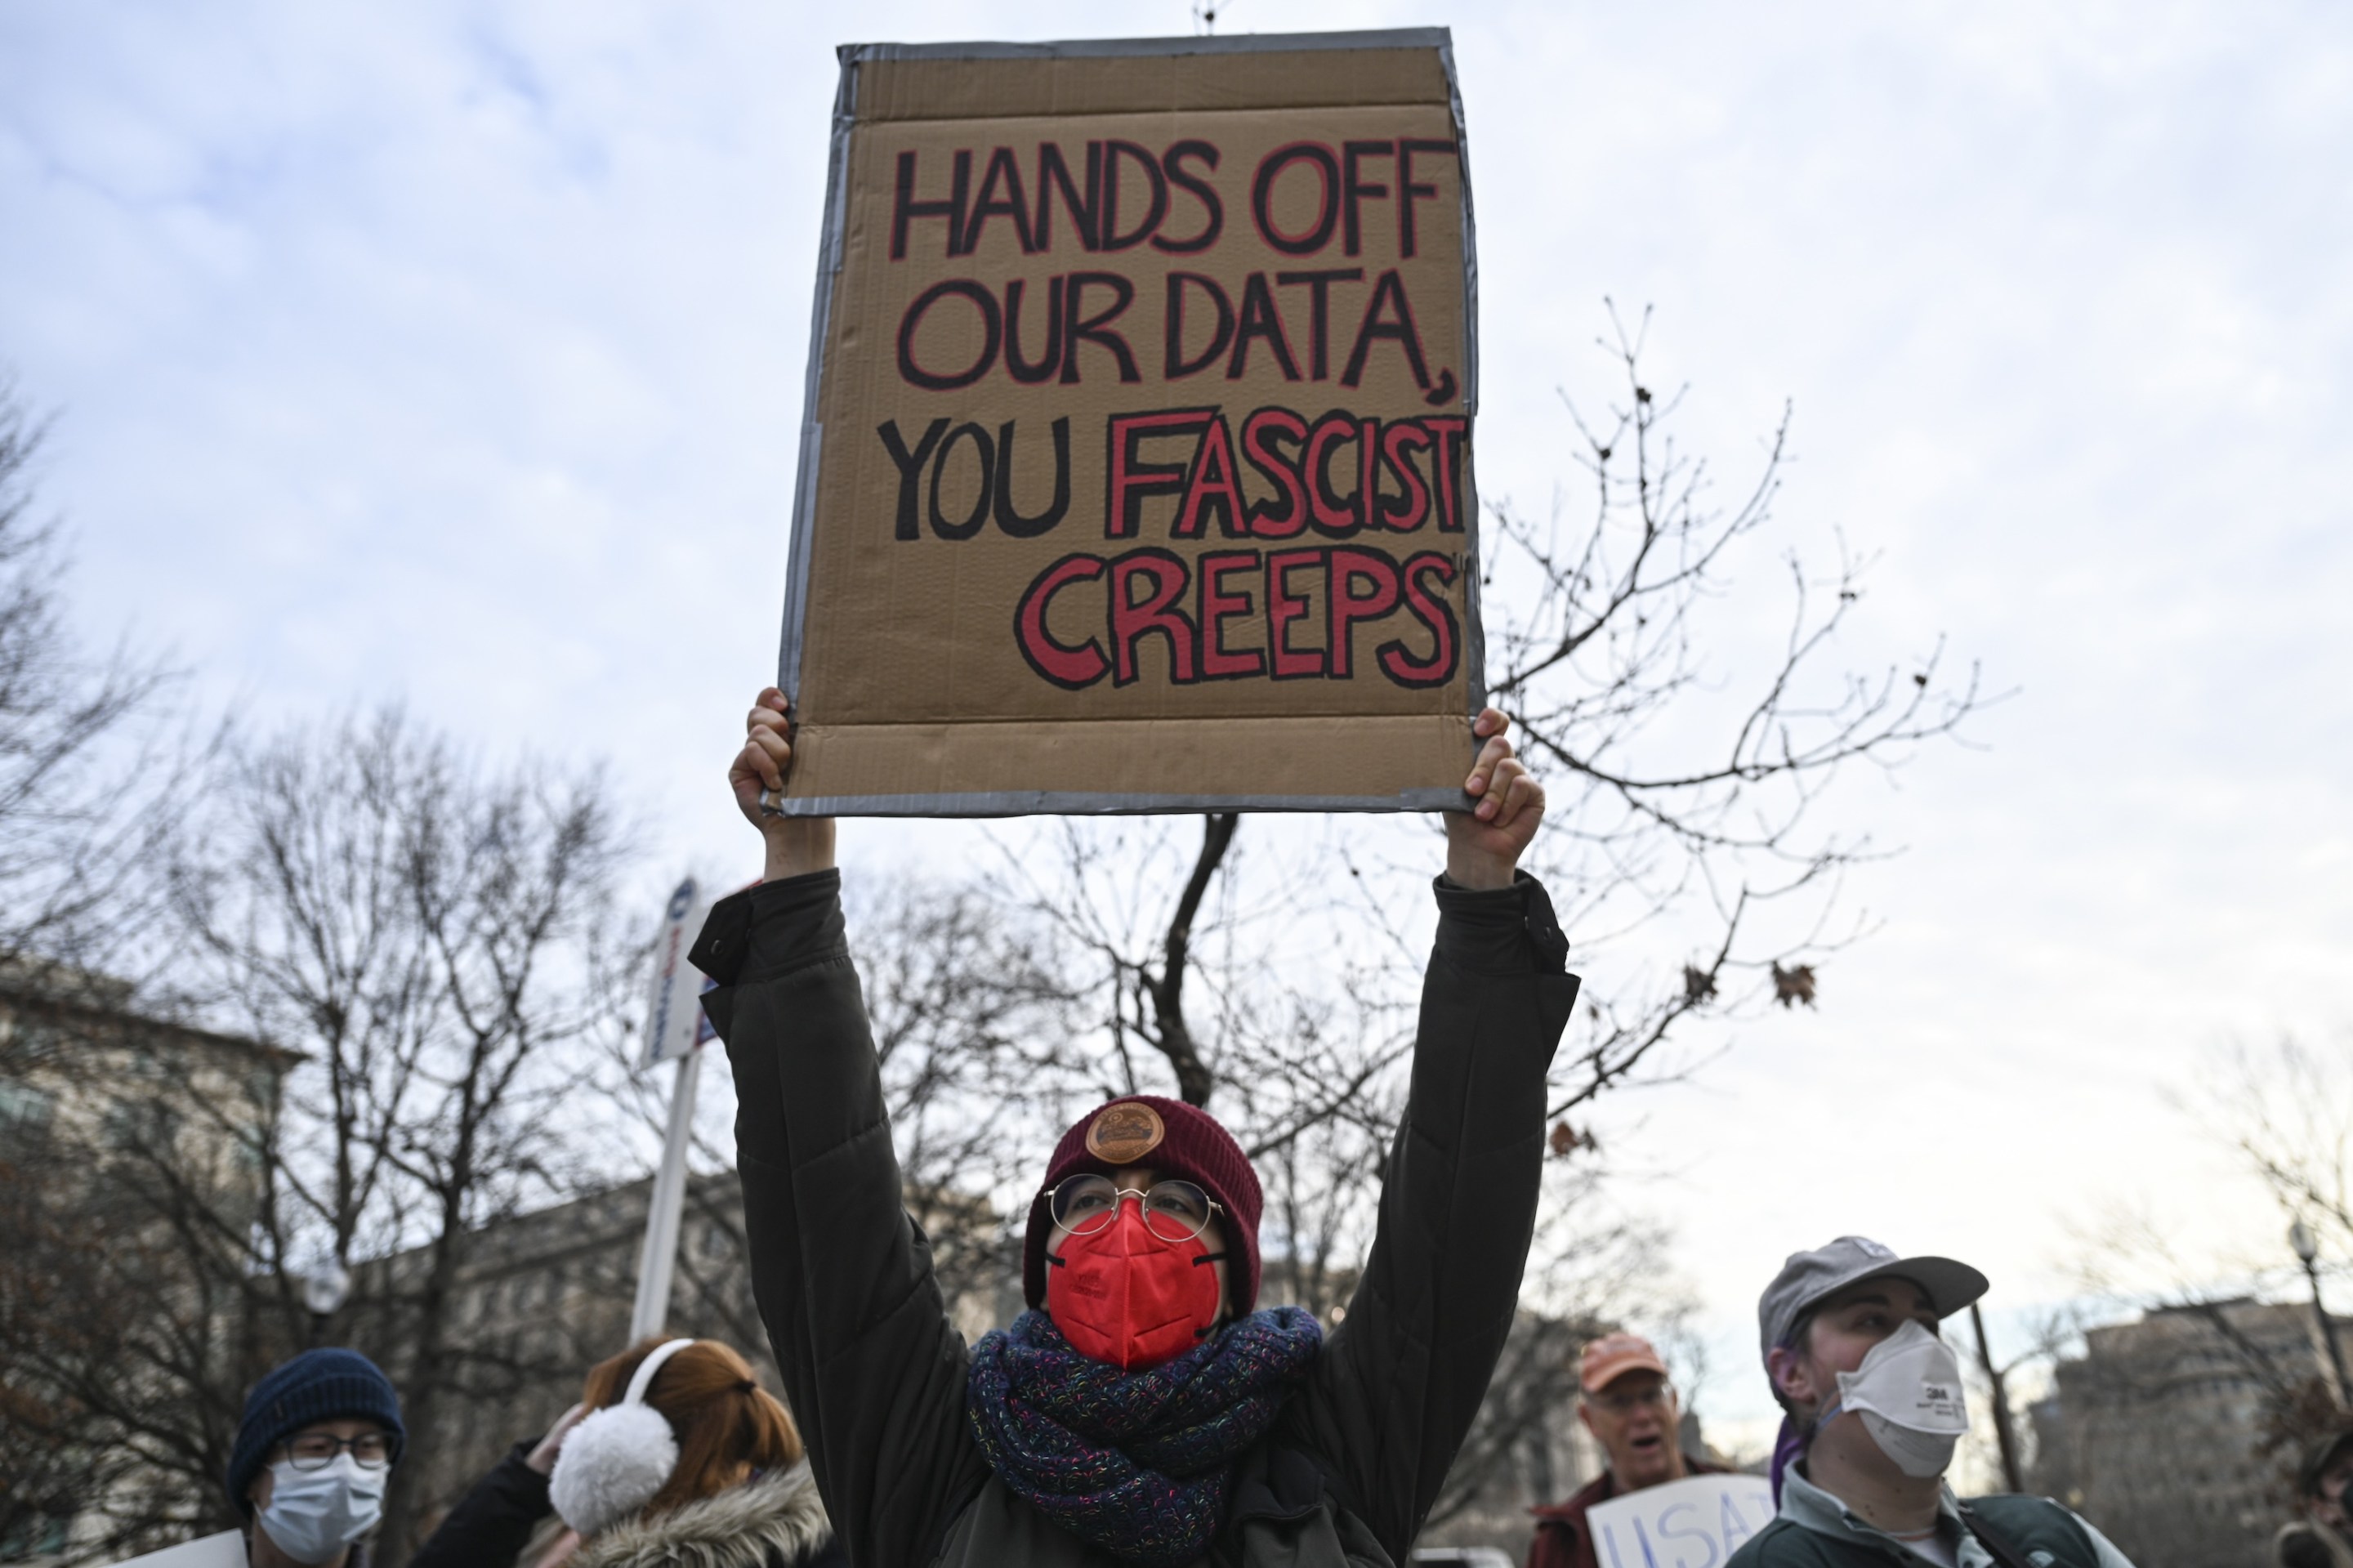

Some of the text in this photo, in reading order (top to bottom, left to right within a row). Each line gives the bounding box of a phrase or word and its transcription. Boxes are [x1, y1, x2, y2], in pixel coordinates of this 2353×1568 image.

[891, 138, 1458, 260] HANDS OFF
[896, 267, 1459, 404] OUR DATA,
[877, 405, 1468, 541] YOU FASCIST
[1014, 546, 1460, 690] CREEPS
